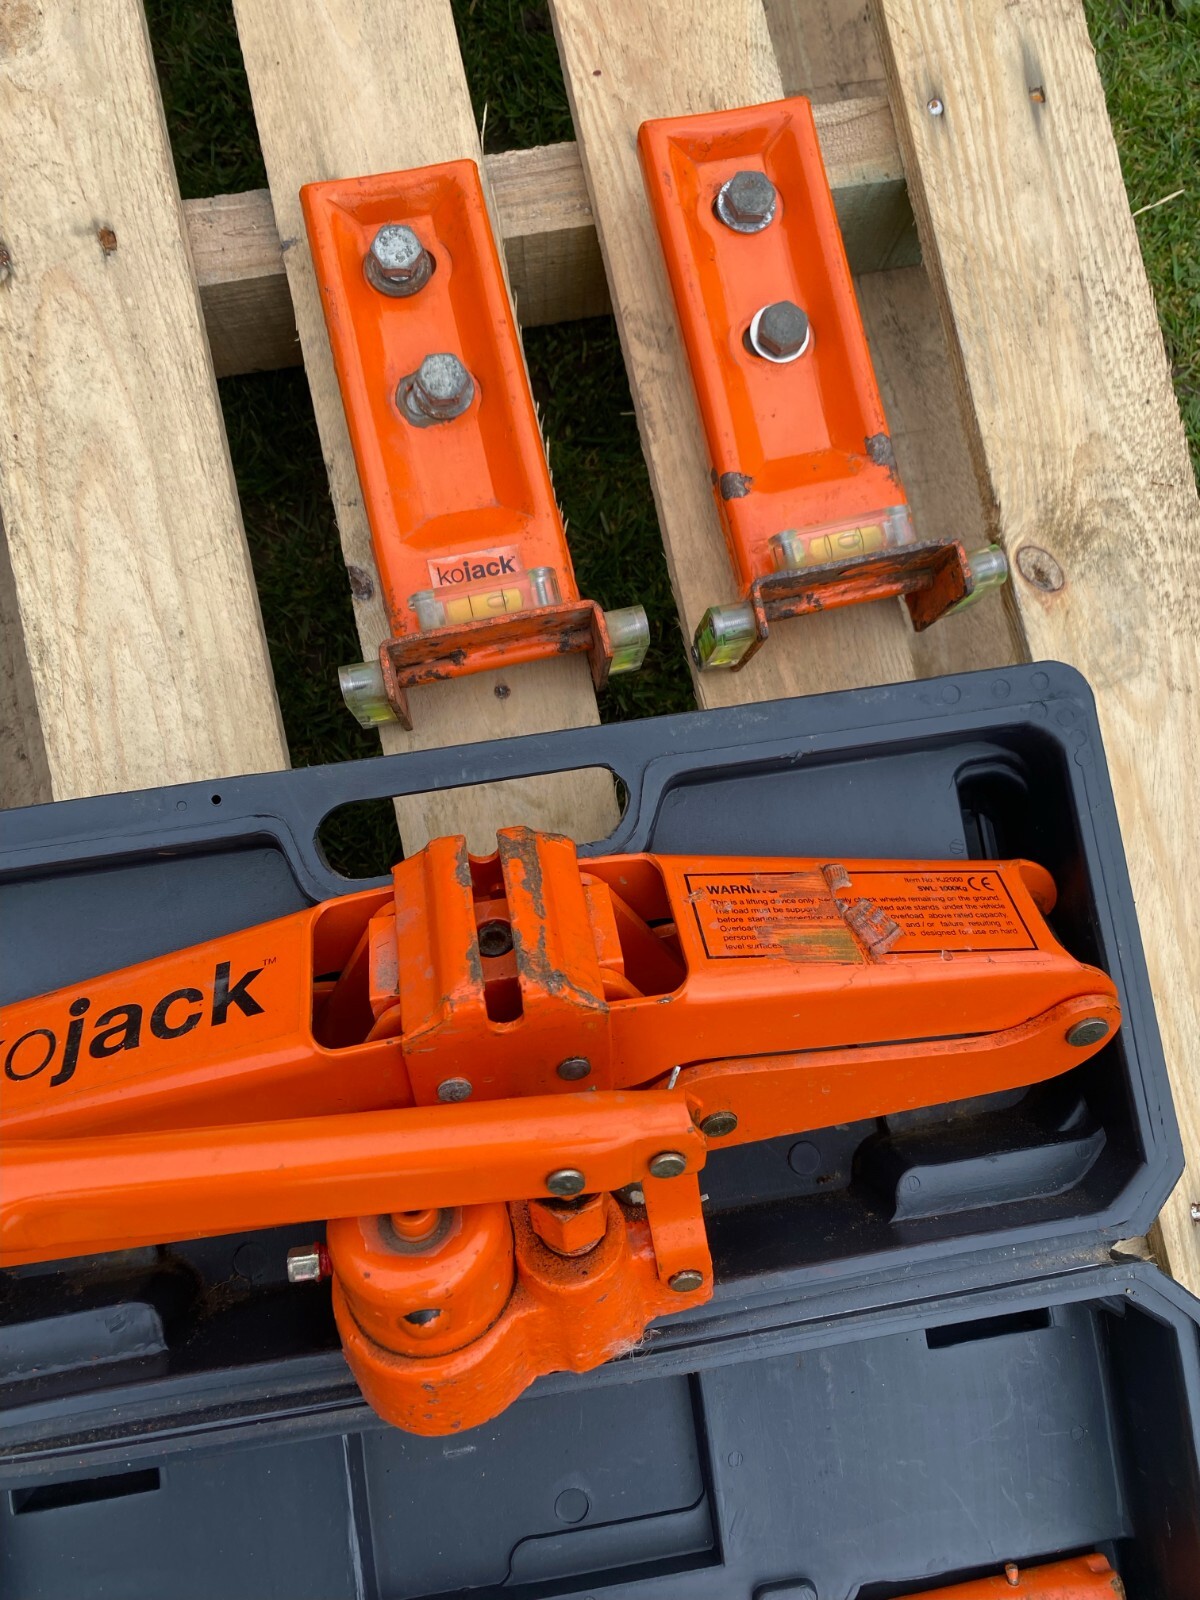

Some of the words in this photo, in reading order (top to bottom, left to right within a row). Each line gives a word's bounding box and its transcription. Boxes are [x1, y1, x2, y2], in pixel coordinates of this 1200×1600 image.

[437, 555, 517, 586] kojack
[706, 885, 778, 895] WARN
[746, 898, 769, 906] lifting
[920, 929, 957, 937] designed
[0, 960, 266, 1088] ojack
